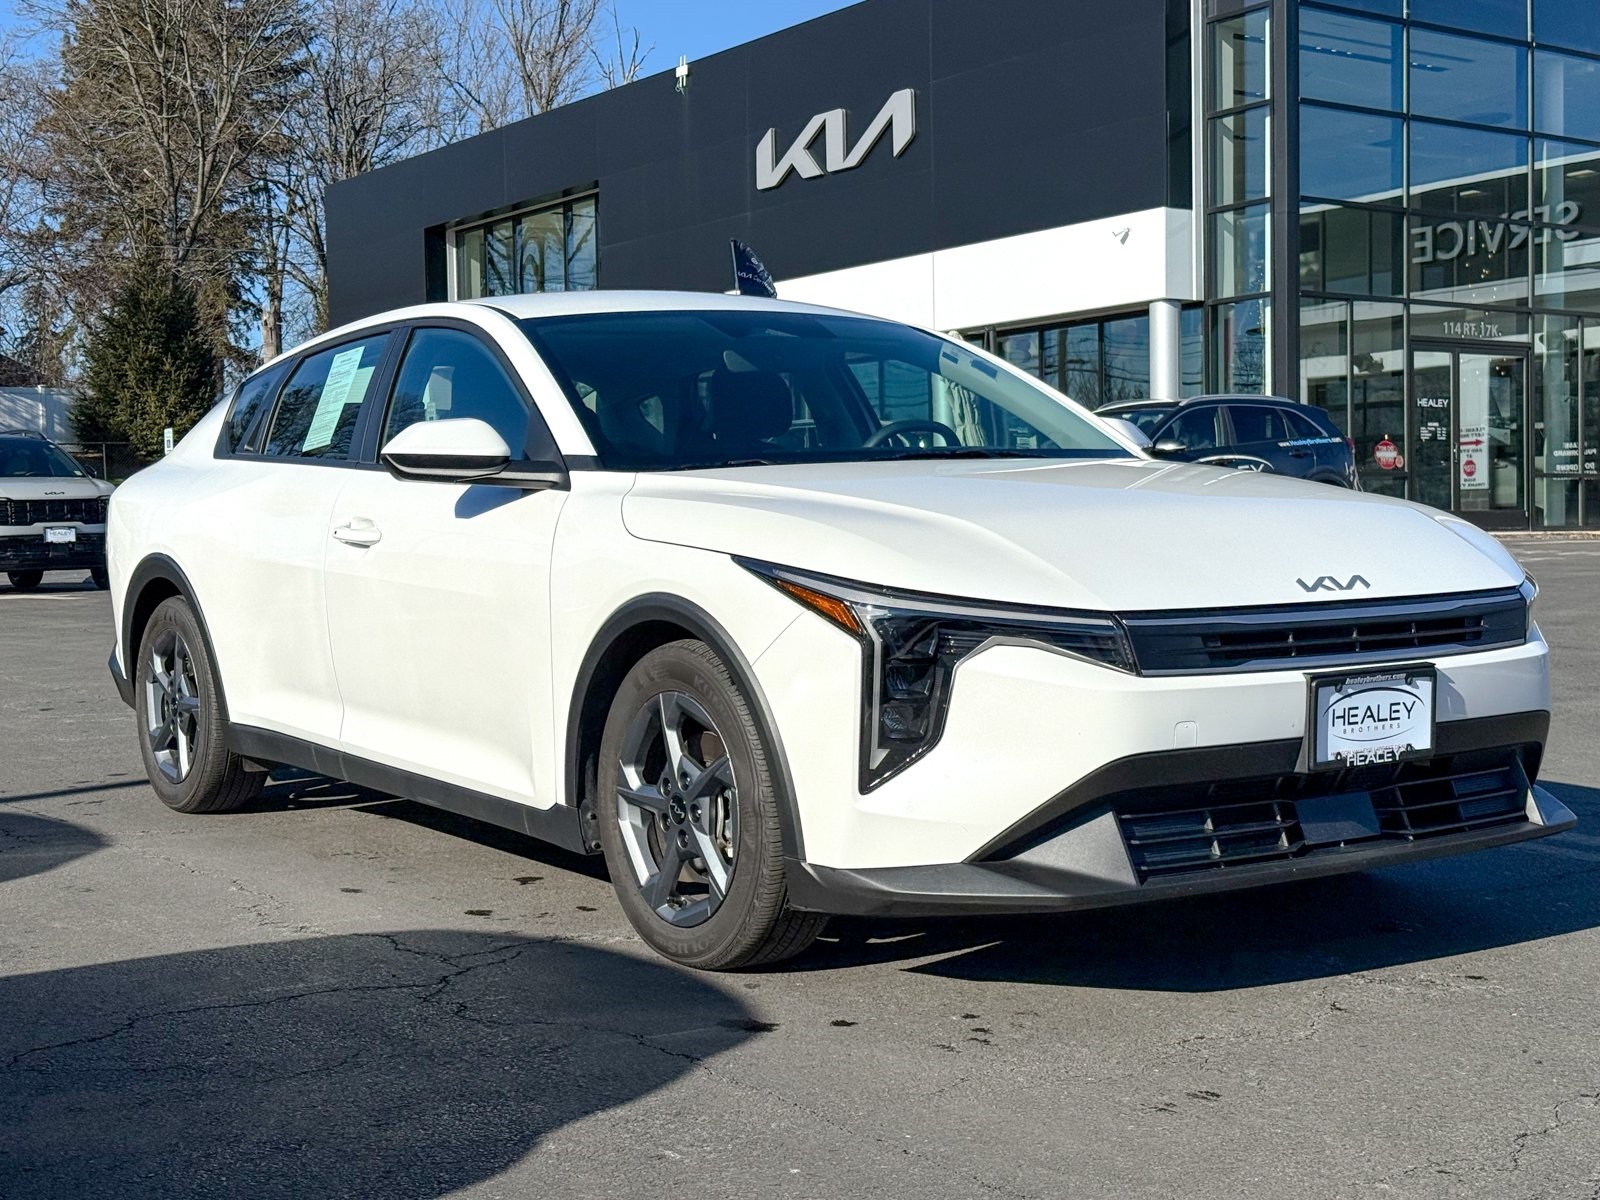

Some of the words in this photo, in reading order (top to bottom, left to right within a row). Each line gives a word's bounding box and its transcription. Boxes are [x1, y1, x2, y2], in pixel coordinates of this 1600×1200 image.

[756, 88, 916, 190] KIA
[1443, 322, 1462, 335] 114
[1417, 398, 1449, 408] HEALEY
[1296, 574, 1371, 593] KIA
[1332, 700, 1416, 728] HEALEY
[1342, 723, 1401, 735] BROTHERS
[1346, 749, 1402, 767] HEALEY
